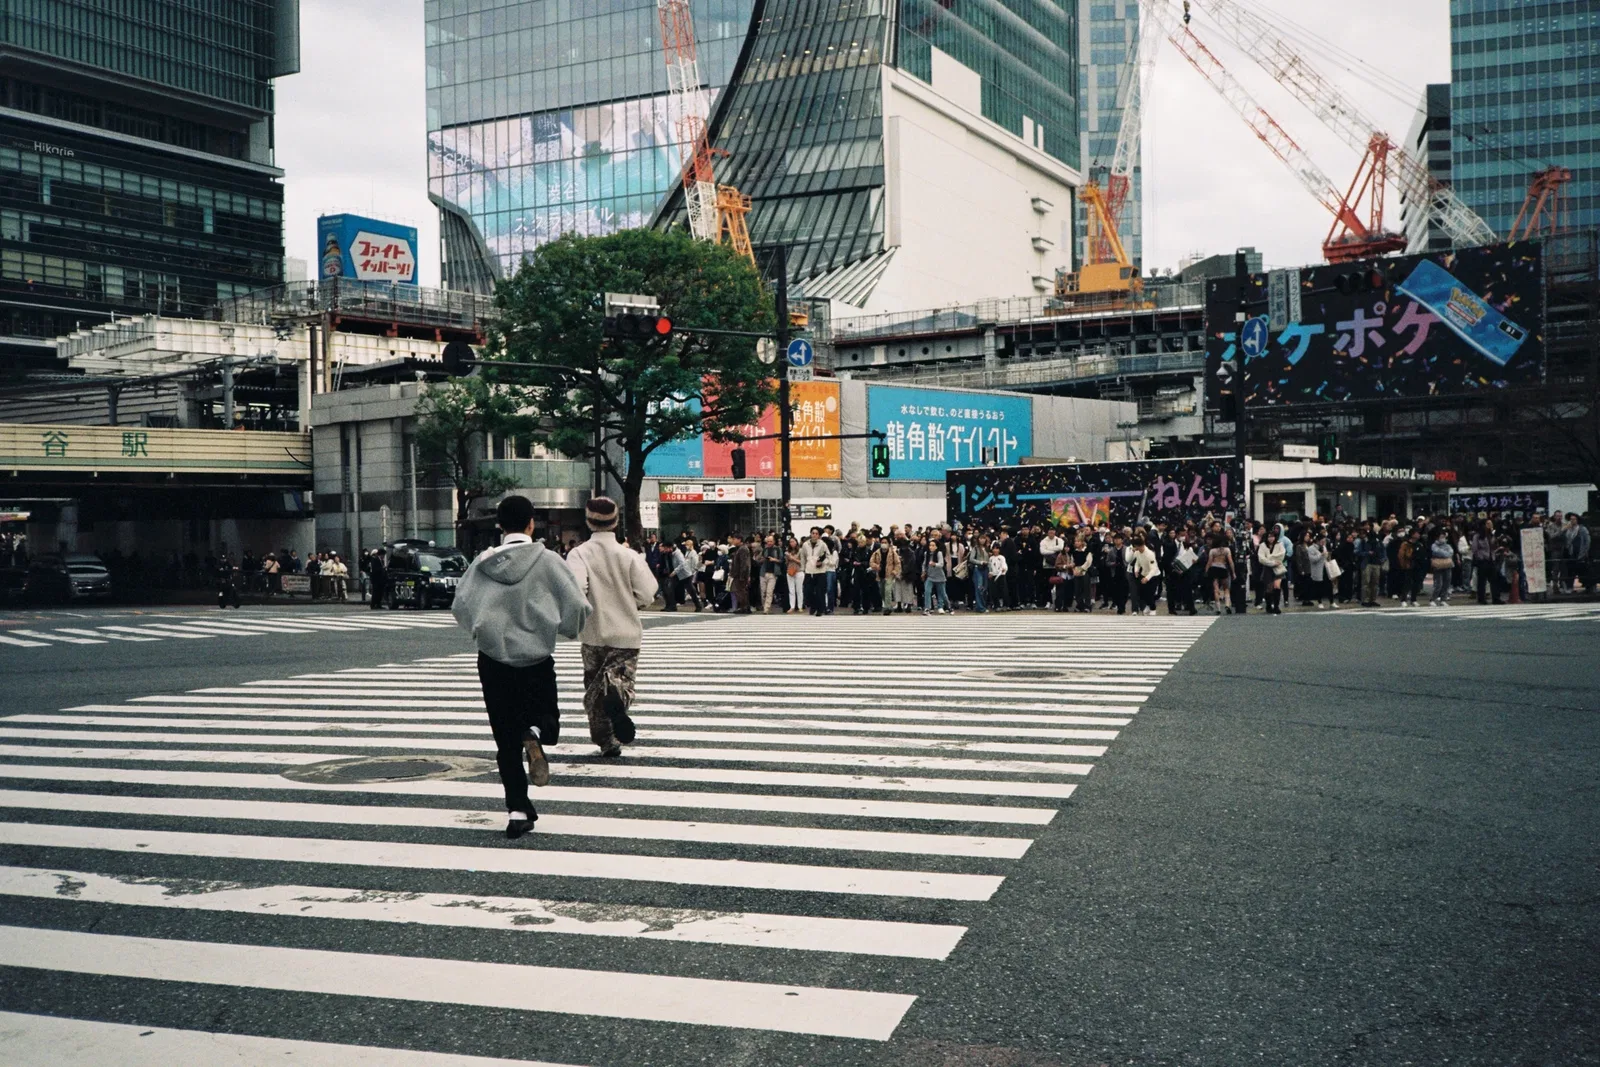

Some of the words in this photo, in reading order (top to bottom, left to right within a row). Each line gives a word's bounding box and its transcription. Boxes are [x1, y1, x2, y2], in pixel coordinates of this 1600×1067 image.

[34, 141, 75, 158] Hikarie
[359, 240, 406, 260] ファイト
[360, 260, 411, 276] イッパーツ!
[900, 404, 1005, 421] 水なしで飲む、のど直接うるおう
